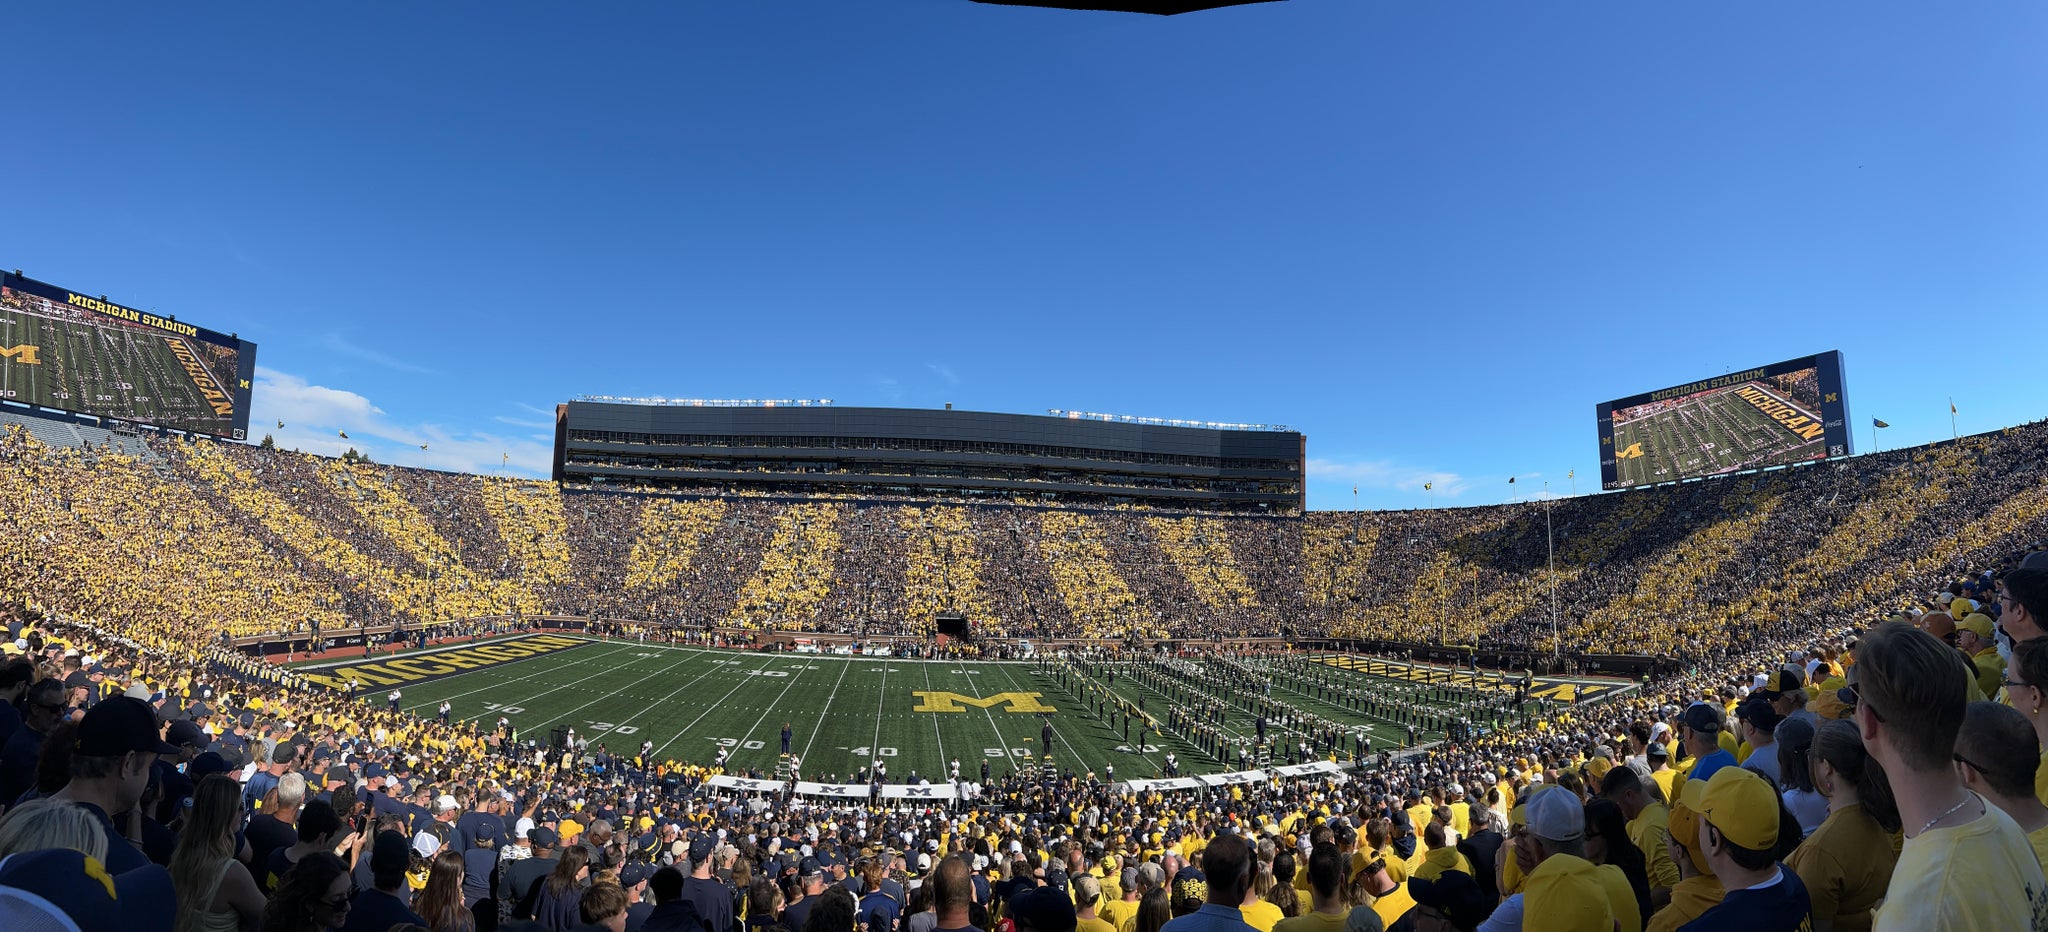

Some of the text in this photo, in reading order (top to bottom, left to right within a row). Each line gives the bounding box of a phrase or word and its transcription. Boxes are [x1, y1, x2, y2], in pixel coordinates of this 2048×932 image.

[68, 292, 198, 337] MICHIGAN STADIUM
[164, 337, 233, 416] MICHIGAN
[1651, 368, 1766, 401] MICHIGAN STADIUM
[1825, 392, 1837, 403] M
[1734, 386, 1825, 442] MICHIGAN
[305, 635, 588, 692] MICHIGAN
[911, 691, 1058, 713] M
[589, 721, 639, 735] 20
[715, 737, 766, 750] 30
[850, 746, 898, 758] 40
[983, 748, 1032, 758] 50
[1299, 764, 1325, 774] M
[734, 779, 760, 788] M
[1222, 773, 1248, 783] M
[820, 785, 847, 794] M
[1151, 780, 1178, 789] M
[906, 786, 932, 797] M
